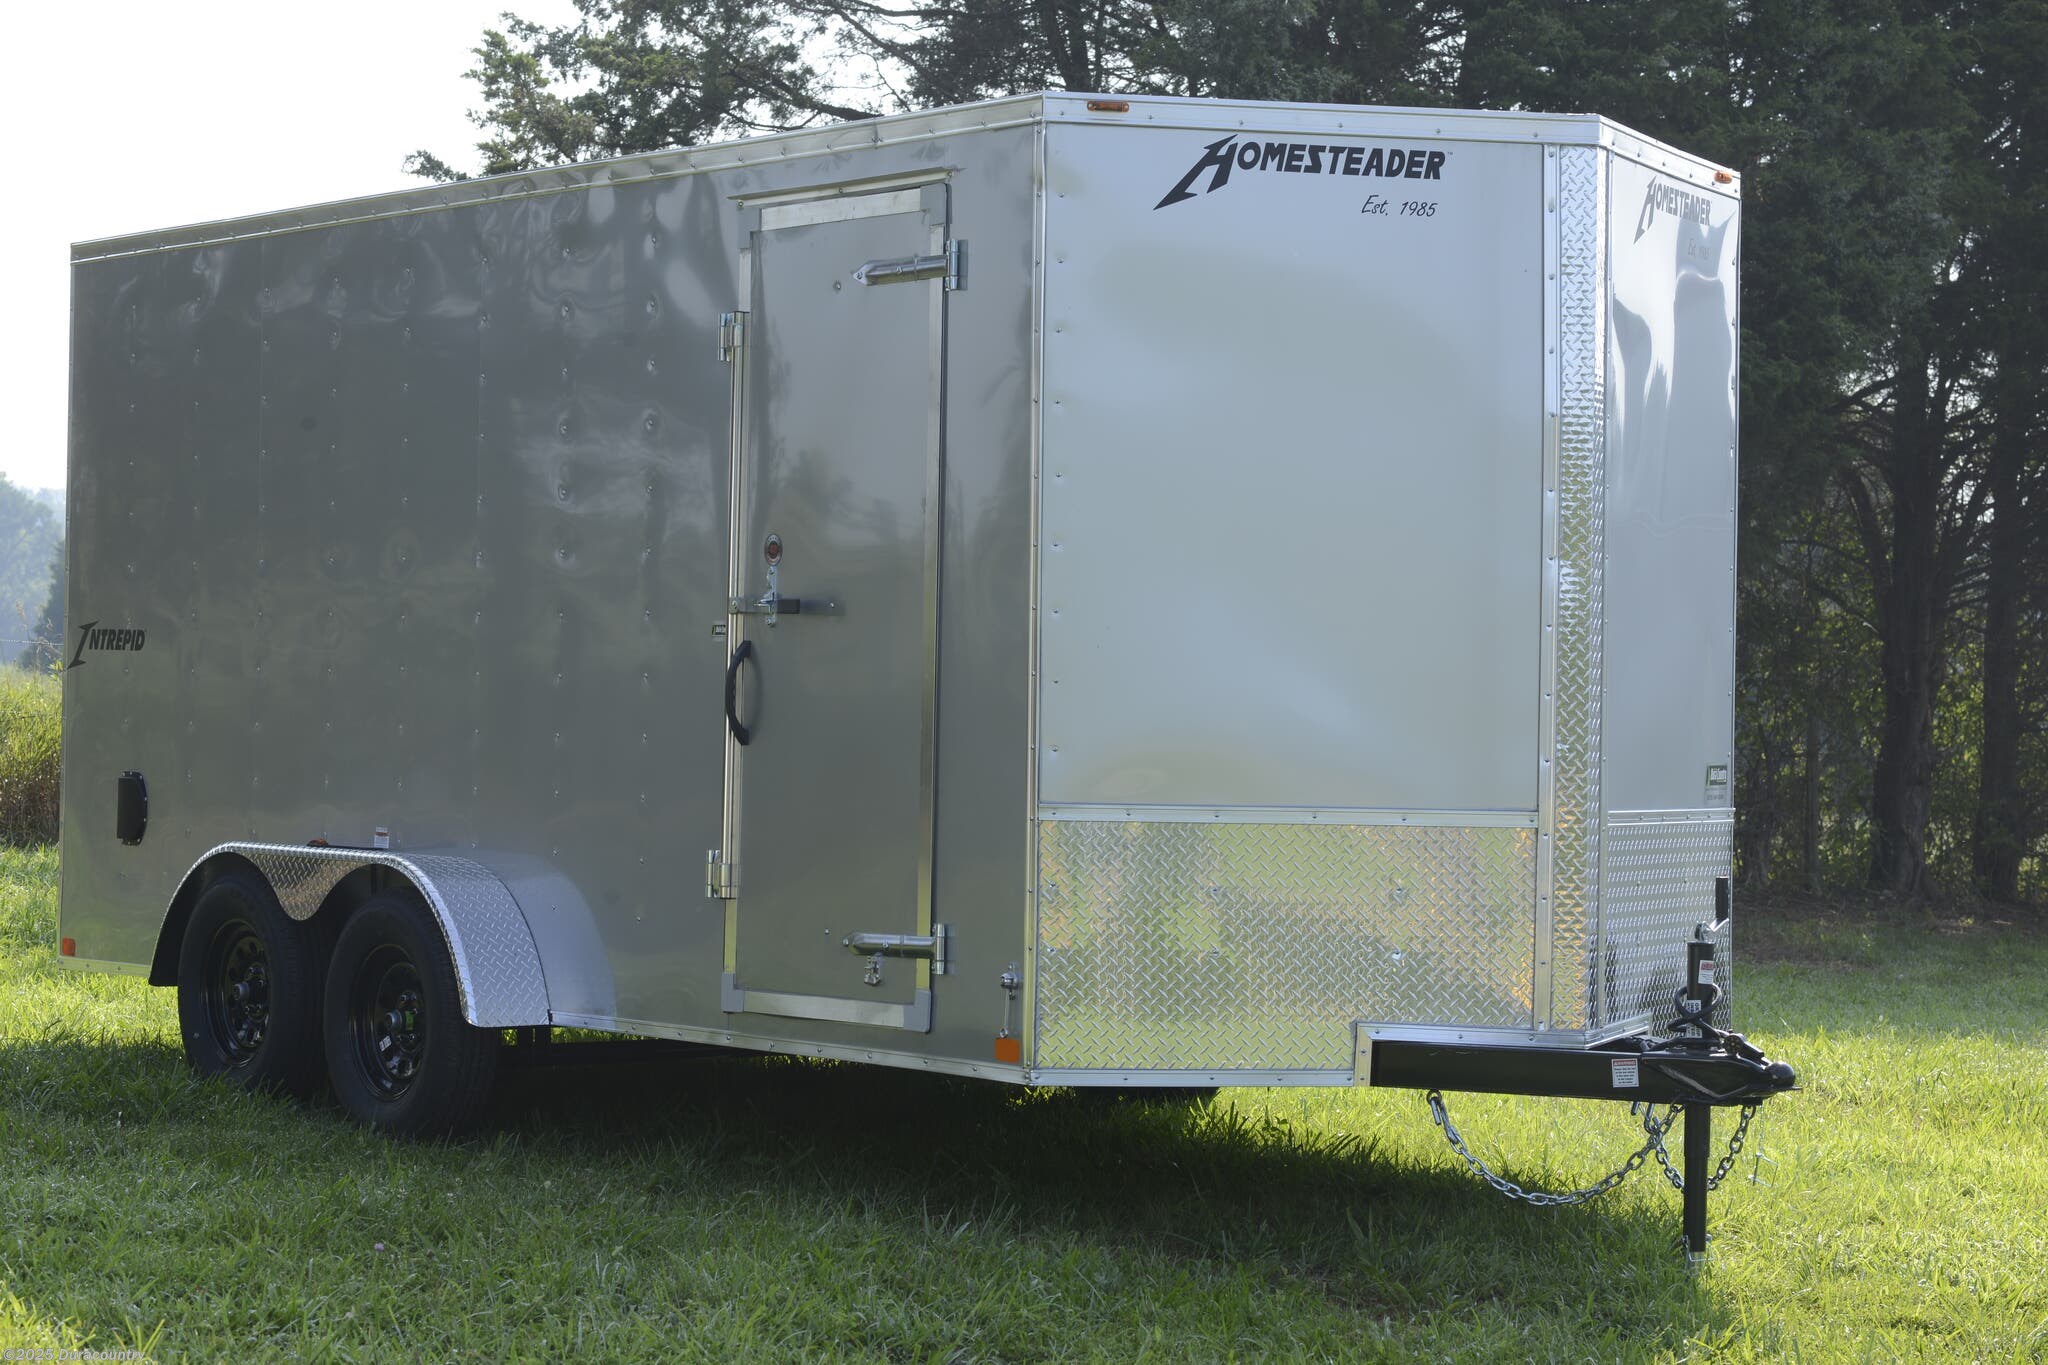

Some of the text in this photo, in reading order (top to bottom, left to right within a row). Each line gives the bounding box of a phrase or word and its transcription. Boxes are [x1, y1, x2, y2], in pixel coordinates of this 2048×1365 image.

[1153, 133, 1446, 211] HOMESTEADER
[1361, 194, 1438, 217] Est. 1985
[1633, 174, 1711, 245] HOMESTEADER
[67, 620, 146, 670] INTREPID
